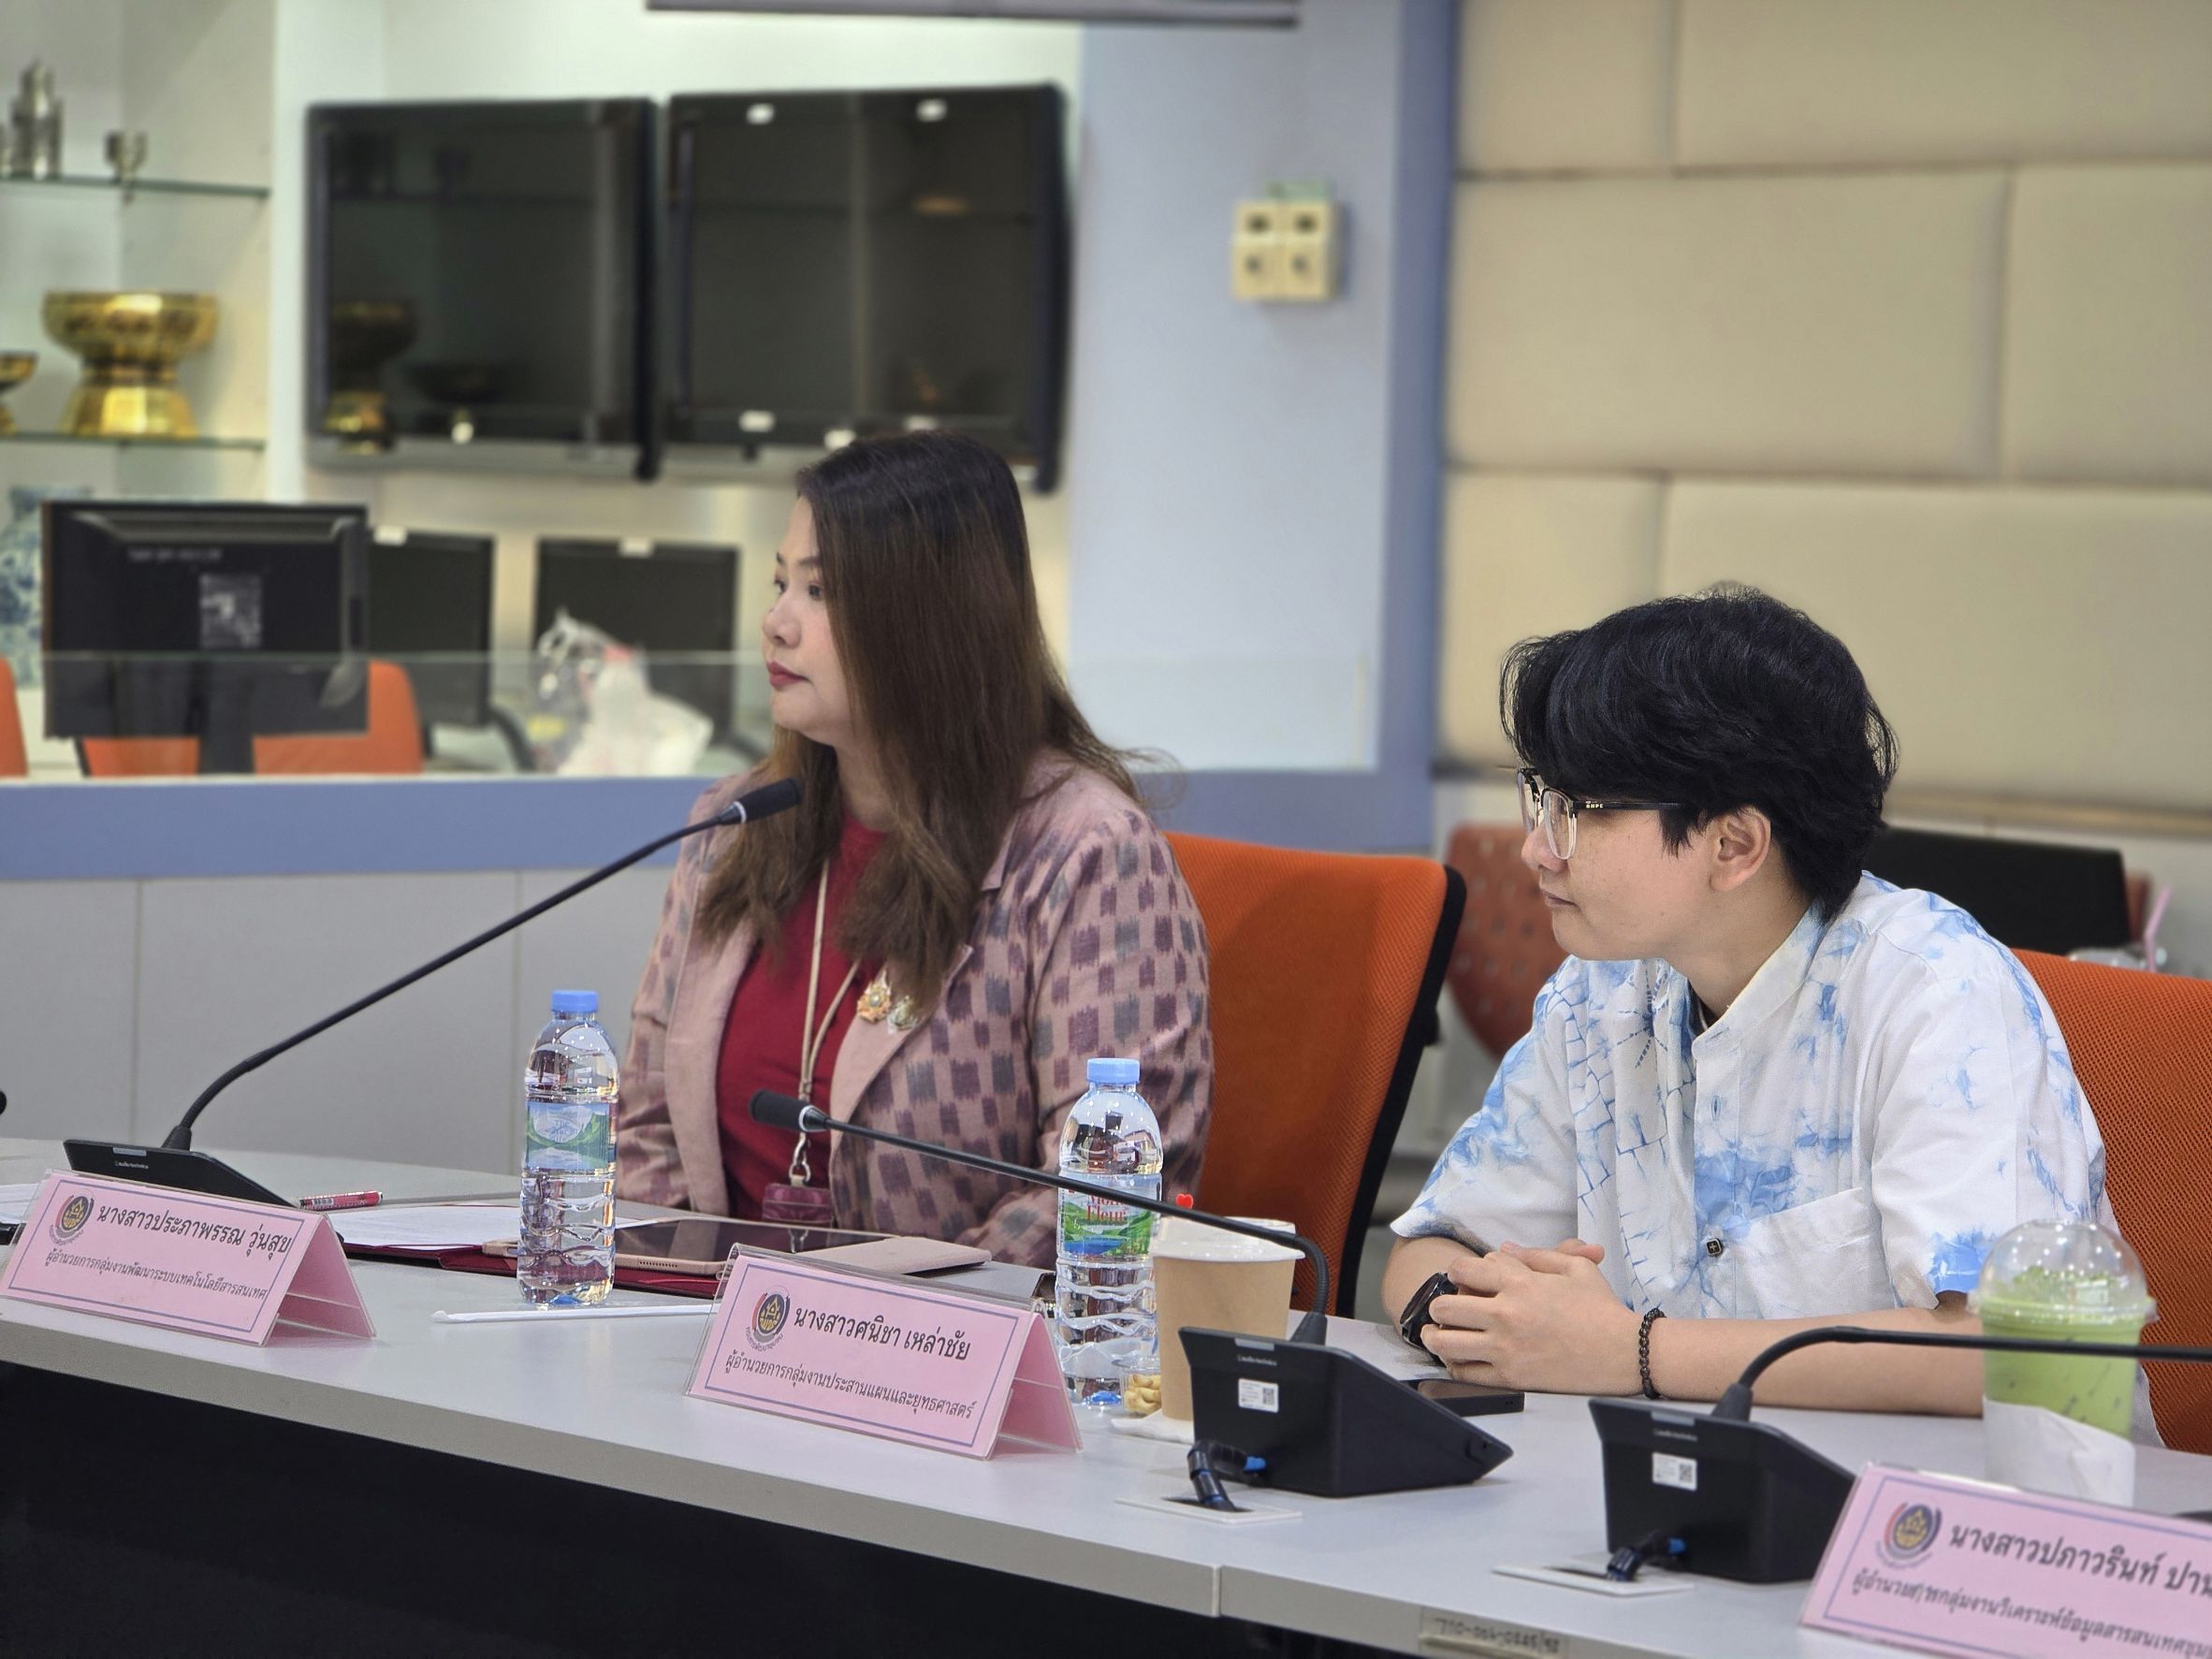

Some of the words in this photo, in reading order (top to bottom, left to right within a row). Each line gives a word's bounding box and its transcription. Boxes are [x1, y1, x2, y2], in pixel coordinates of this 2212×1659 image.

[96, 1203, 246, 1246] นางสาวประภาพรรณ
[246, 1223, 292, 1260] วุ่นสุข
[793, 1306, 901, 1347] นางสาวศนิชา
[904, 1326, 971, 1361] เหล่าชัย
[725, 1352, 977, 1420] ผู้อำนวยการกลุ่มงานประสานแผนและยุทธศาสตร์
[1949, 1523, 2167, 1586] นางสาวปภาวรินท์
